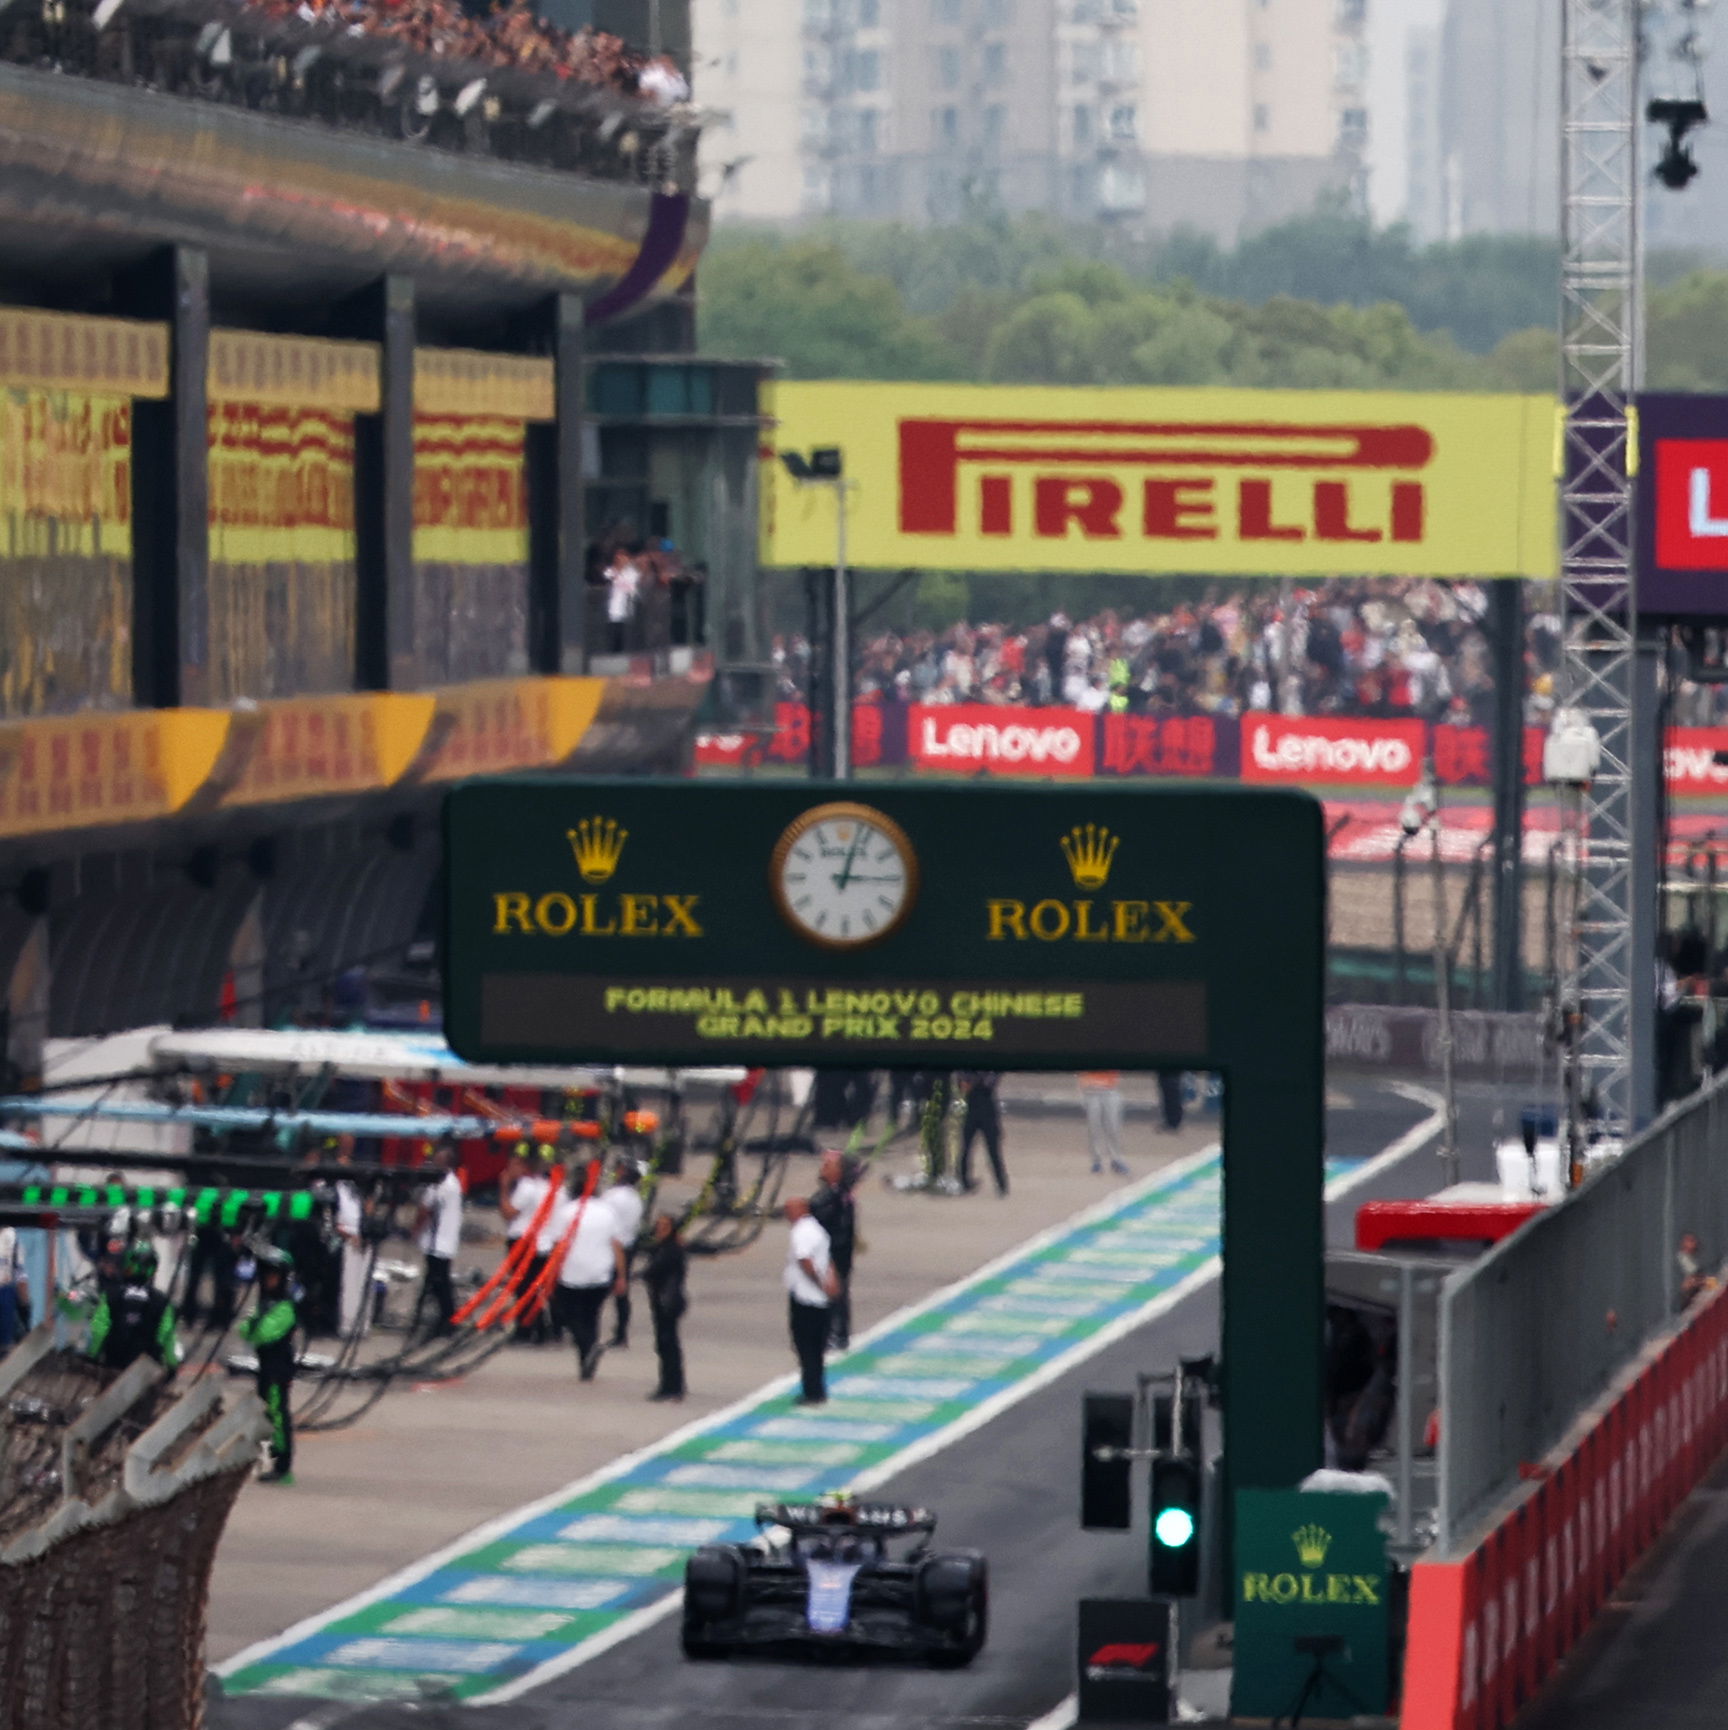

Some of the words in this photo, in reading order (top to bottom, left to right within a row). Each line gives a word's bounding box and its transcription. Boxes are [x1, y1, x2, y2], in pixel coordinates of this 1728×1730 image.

[898, 418, 1436, 541] PIRELLI
[921, 716, 1082, 764] Lenovo
[1252, 723, 1412, 773] Lenovo
[492, 891, 704, 937] ROLEX
[984, 898, 1197, 944] ROLEX
[604, 987, 765, 1014] FORMULA
[806, 989, 940, 1016] LENOVO
[950, 992, 1086, 1018] CHINESE
[696, 1013, 813, 1040] GRAND
[823, 1014, 903, 1041] PRIX
[909, 1017, 994, 1042] 2024
[1242, 1572, 1382, 1604] ROLEX
